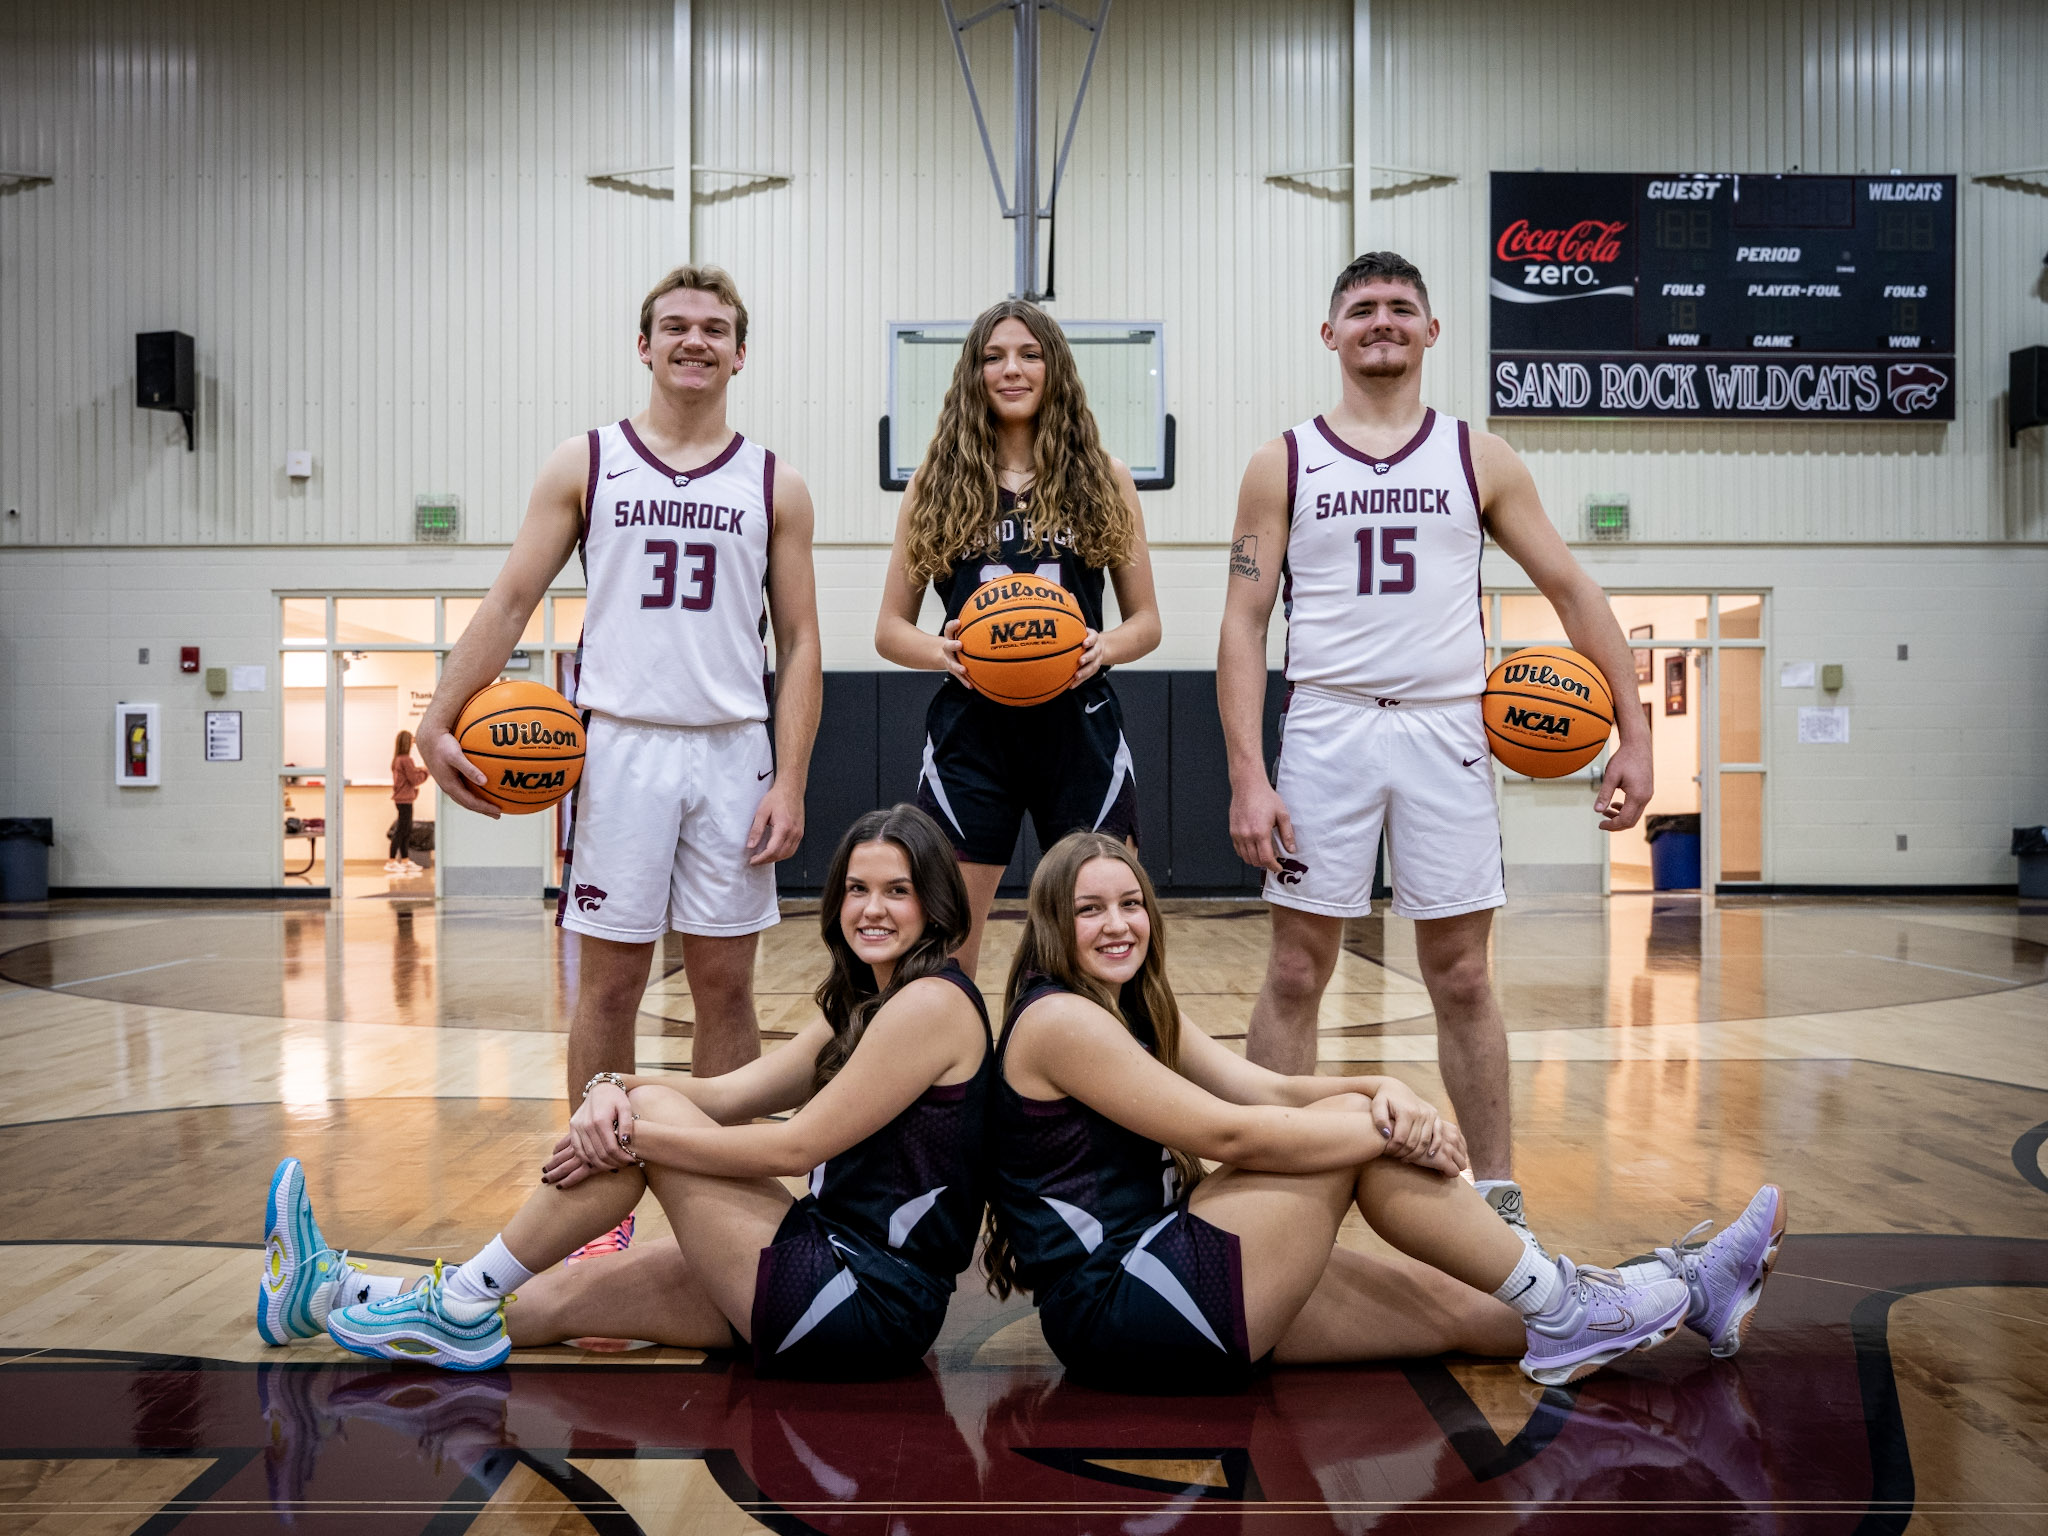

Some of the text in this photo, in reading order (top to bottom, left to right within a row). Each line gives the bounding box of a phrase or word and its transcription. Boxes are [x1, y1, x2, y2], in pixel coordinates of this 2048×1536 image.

[1646, 180, 1722, 200] GUEST
[1868, 182, 1943, 202] WILDCATS
[1497, 218, 1628, 262] Coca-Cola
[1735, 246, 1801, 263] PERIOD
[1661, 283, 1706, 297] FOULS
[1747, 284, 1842, 298] PLAYER-FOUL
[1883, 285, 1928, 298] FOULS
[1667, 333, 1700, 346] WON
[1752, 334, 1794, 348] GAME
[1888, 335, 1921, 348] WON
[1495, 360, 1881, 412] SAND ROCK WILDCATS
[614, 499, 746, 536] SANDROCK
[1315, 488, 1451, 521] SANDROCK
[1353, 526, 1418, 596] 15
[639, 538, 717, 613] 33
[973, 582, 1067, 611] Wilson
[990, 619, 1057, 645] NCAA
[1503, 663, 1591, 703] Wilson
[487, 720, 579, 748] Wilson
[1503, 705, 1571, 737] NCAA
[499, 768, 566, 790] NCAA
